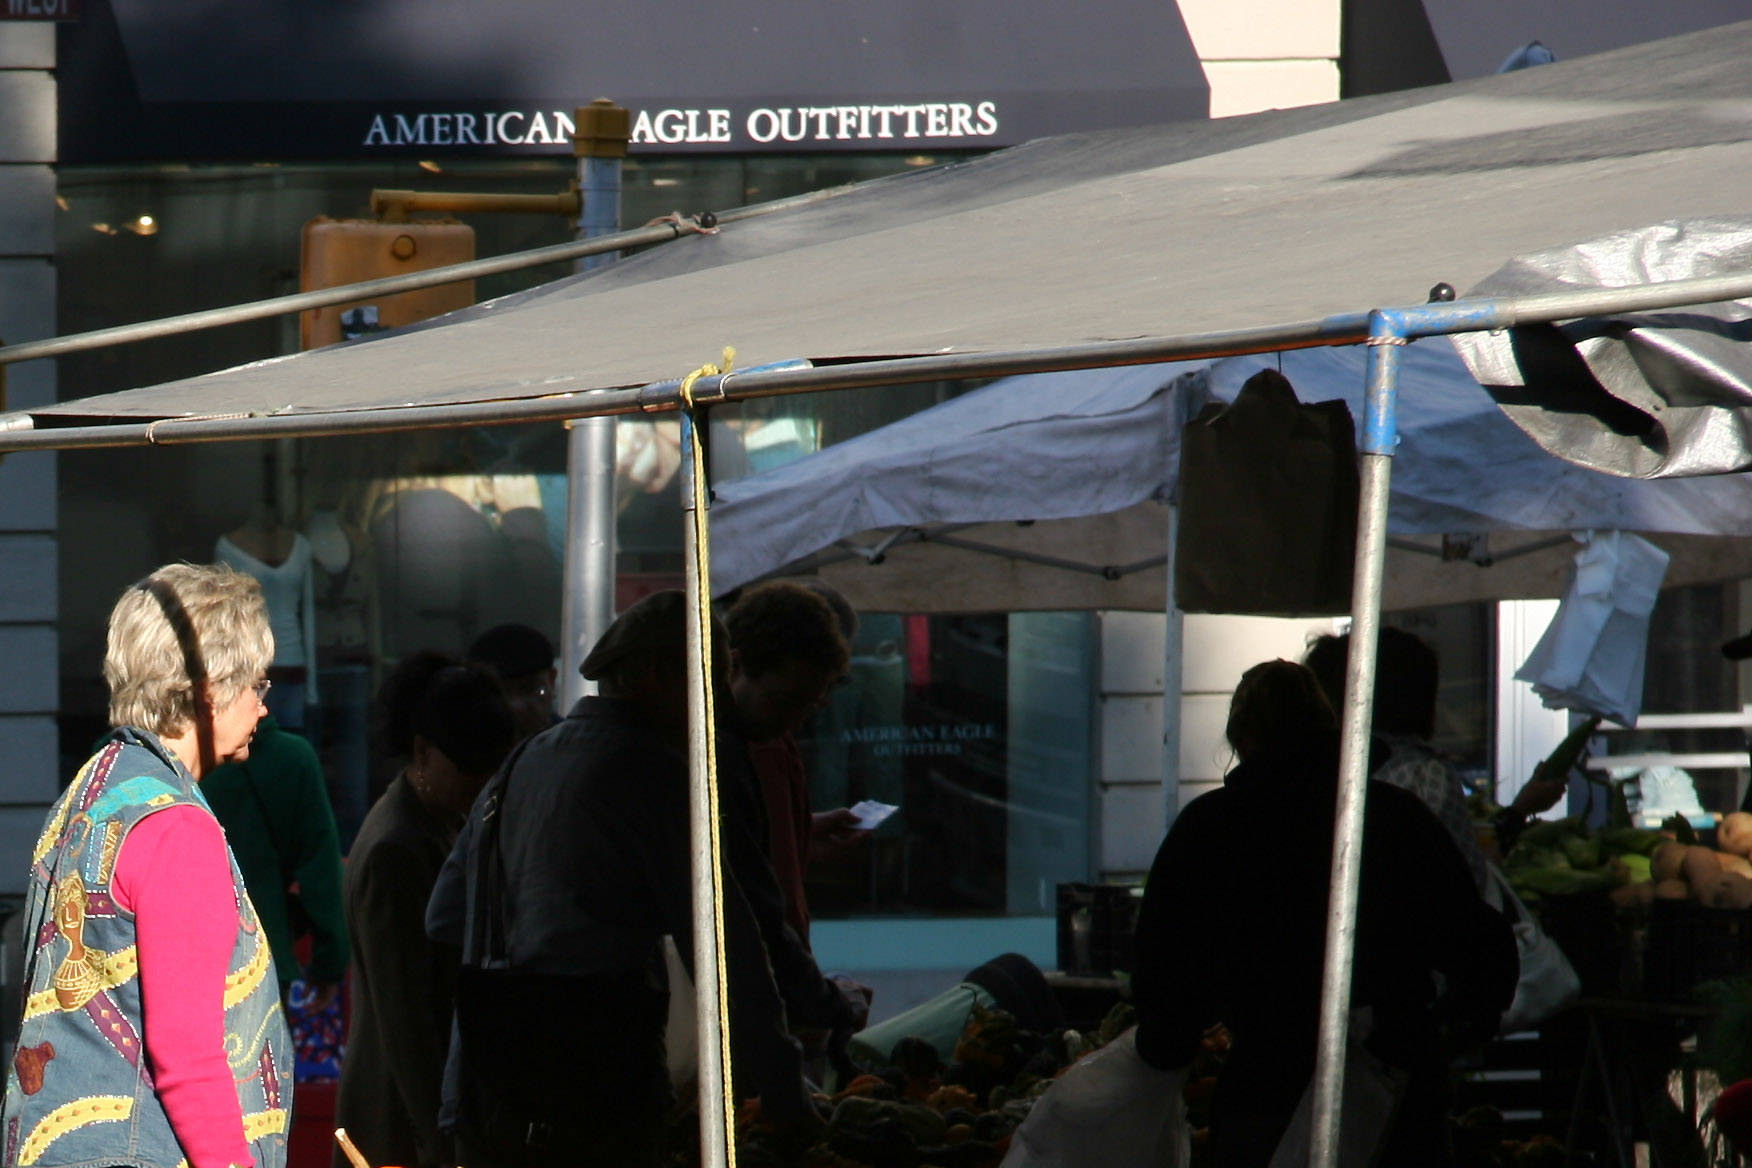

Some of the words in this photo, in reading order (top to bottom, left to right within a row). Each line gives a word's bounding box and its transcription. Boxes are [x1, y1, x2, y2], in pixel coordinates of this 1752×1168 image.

[628, 109, 730, 143] AGLE
[748, 102, 998, 141] OUTFITTERS
[842, 725, 935, 742] AMERICAN
[940, 723, 996, 740] EAGLE
[873, 742, 962, 757] OUTFITTERS
